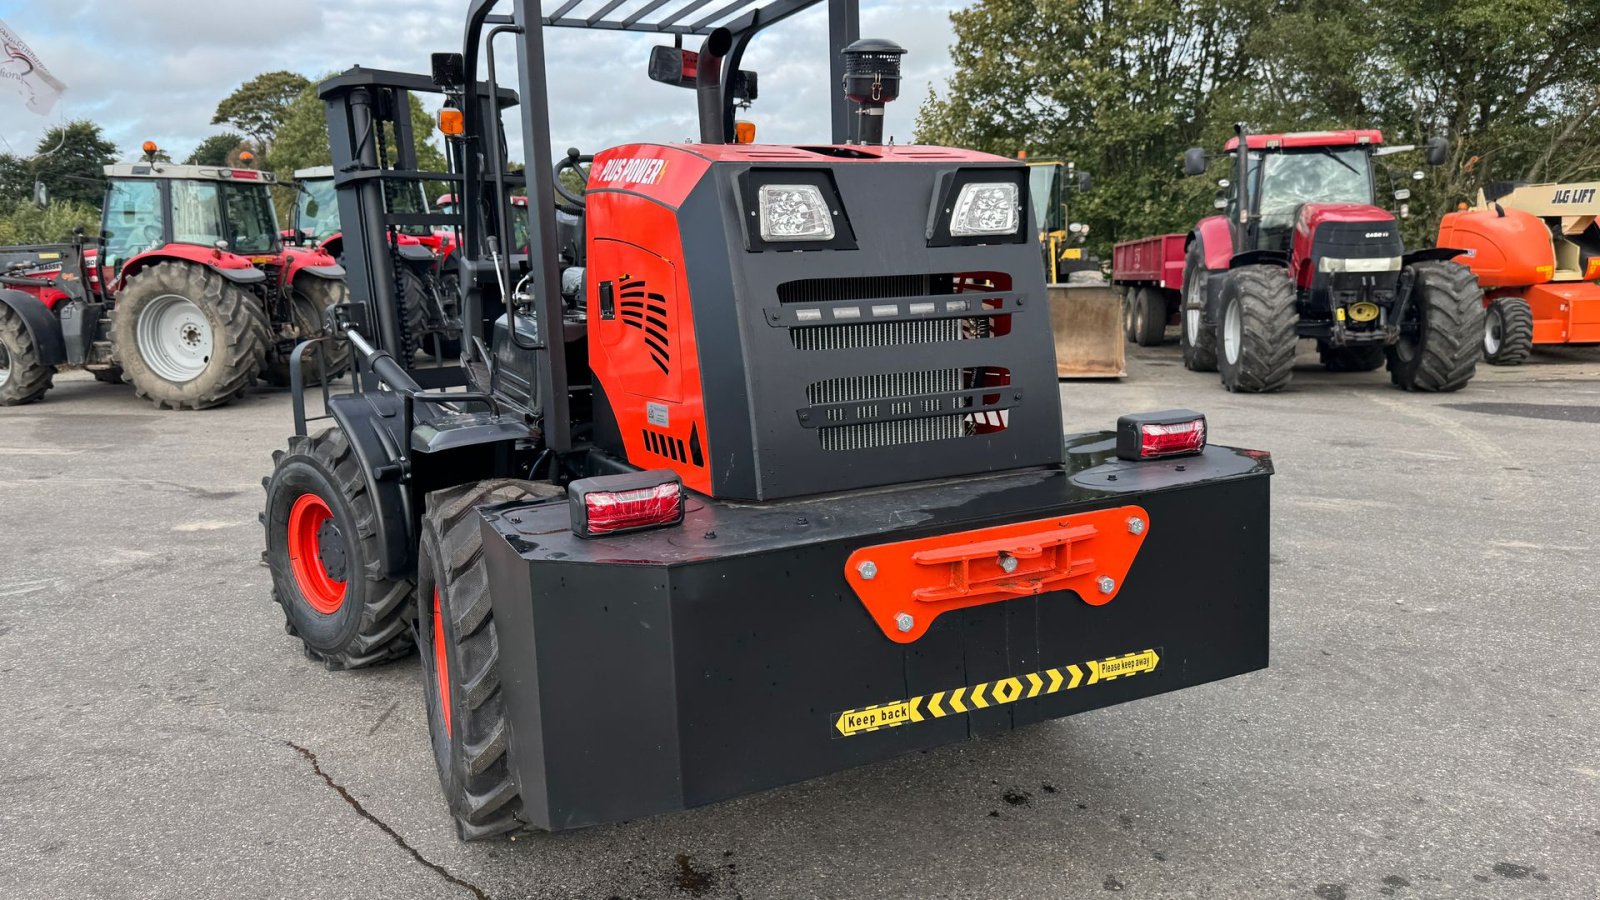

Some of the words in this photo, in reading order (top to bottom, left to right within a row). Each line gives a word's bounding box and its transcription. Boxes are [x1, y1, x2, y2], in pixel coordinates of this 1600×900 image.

[598, 158, 627, 182] PLUS
[618, 158, 664, 184] POWER
[1551, 189, 1571, 204] JLG
[1571, 188, 1596, 204] LIFT
[1102, 663, 1120, 673] Please
[1121, 660, 1134, 670] keep
[1136, 657, 1149, 667] away
[848, 714, 875, 728] Keep
[881, 706, 907, 720] back
